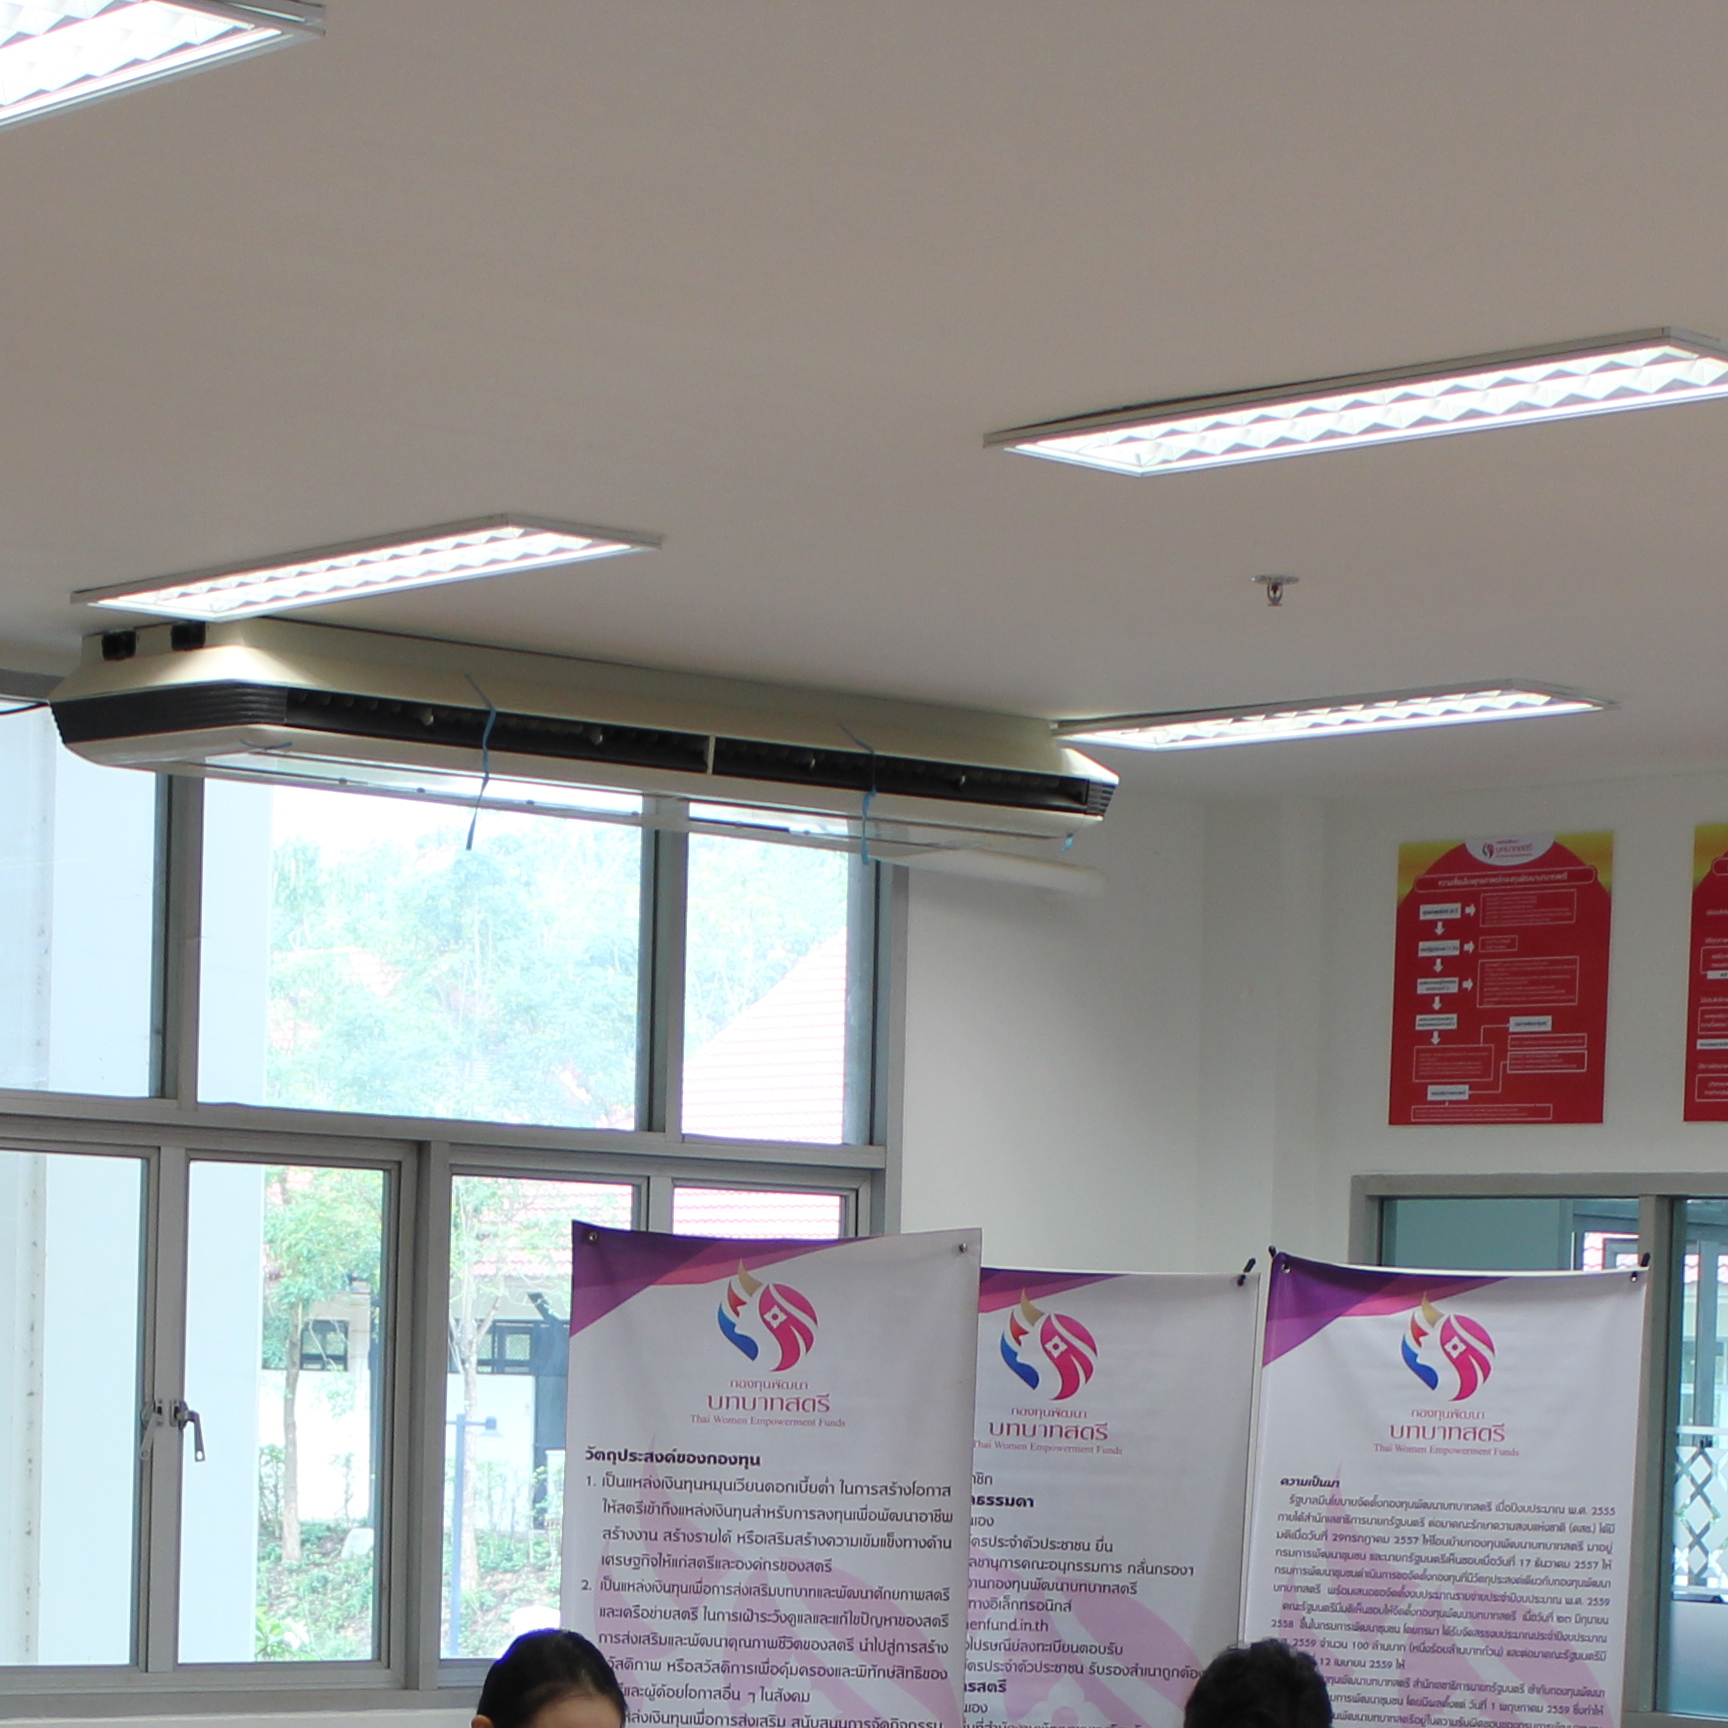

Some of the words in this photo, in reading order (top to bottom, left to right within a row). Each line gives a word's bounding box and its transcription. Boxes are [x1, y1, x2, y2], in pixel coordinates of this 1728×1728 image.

[707, 1393, 831, 1413] บทบาทสตรี
[691, 1413, 710, 1424] Thai
[713, 1415, 747, 1426] Women
[750, 1416, 816, 1428] Empowerment
[818, 1418, 845, 1428] Funds
[989, 1421, 1108, 1441] บทบาทสตรี
[1390, 1424, 1505, 1442] บทบาทสตรี
[994, 1441, 1027, 1450] Women
[1030, 1442, 1094, 1455] Empowerment
[1096, 1445, 1123, 1455] Funds
[1374, 1443, 1393, 1453] Thai
[1395, 1444, 1426, 1454] Women
[1429, 1445, 1491, 1457] Empowerment
[1493, 1448, 1519, 1457] Funds
[585, 1446, 761, 1468] วัตถุประสงค์ของกองทุน
[586, 1475, 597, 1487] 1.
[602, 1471, 834, 1494] เป็นแหล่งเงินทุนหมุนเวียนดอกเบี้ยต่ำ
[839, 1479, 951, 1497] ในการสร้างโอกาส
[1280, 1475, 1340, 1488] ความเป็นมา
[602, 1498, 953, 1524] ให้สตรีเข้าถึงแหล่งเงินทุนสำหรับการลงทุนเพื่อพัฒนาอาชีพ
[1591, 1507, 1615, 1516] 2555
[603, 1526, 658, 1541] สร้างงาน
[663, 1527, 732, 1543] สร้างรายได้
[737, 1530, 952, 1549] หรือเสริมสร้างความเข้มแข็งทางด้าน
[970, 1535, 1091, 1552] ตรประจำตัวประชาชน
[1095, 1536, 1113, 1552] ยื่น
[1394, 1536, 1419, 1545] 2557
[602, 1552, 832, 1572] เศรษฐกิจให้แก่สตรีและองค์กรของสตรี
[1520, 1559, 1531, 1567] 17
[1574, 1561, 1599, 1570] 2557
[581, 1579, 592, 1590] 2.
[601, 1576, 950, 1601] เป็นแหล่งเงินทุนเพื่อการส่งเสริมบทบาทและพัฒนาศักยภาพสตรี
[1273, 1584, 1321, 1594] บทบาทสตรี
[1587, 1597, 1610, 1606] 2559
[968, 1596, 1072, 1612] ทางอิเล็กทรอนิกส์
[600, 1604, 698, 1621] และเครือข่ายสตรี
[703, 1605, 949, 1628] ในการเฝ้าระวังดูแลและแก้ไขปัญหาของสตรี
[599, 1631, 854, 1651] การส่งเสริมและพัฒนาคุณภาพชีวิตของสตรี
[859, 1636, 949, 1656] นำไปสู่การสร้าง
[1292, 1638, 1317, 1650] 2559
[1352, 1641, 1370, 1650] 100
[667, 1658, 948, 1680] หรือสวัสดิการเพื่อคุ้มครองและพิทักษ์สิทธิของ
[964, 1660, 1084, 1675] ตรประจำตัวประชาชน
[1320, 1658, 1331, 1666] 12
[1369, 1660, 1393, 1669] 2559
[760, 1686, 810, 1703] ในสังคม
[1547, 1705, 1570, 1715] 2559
